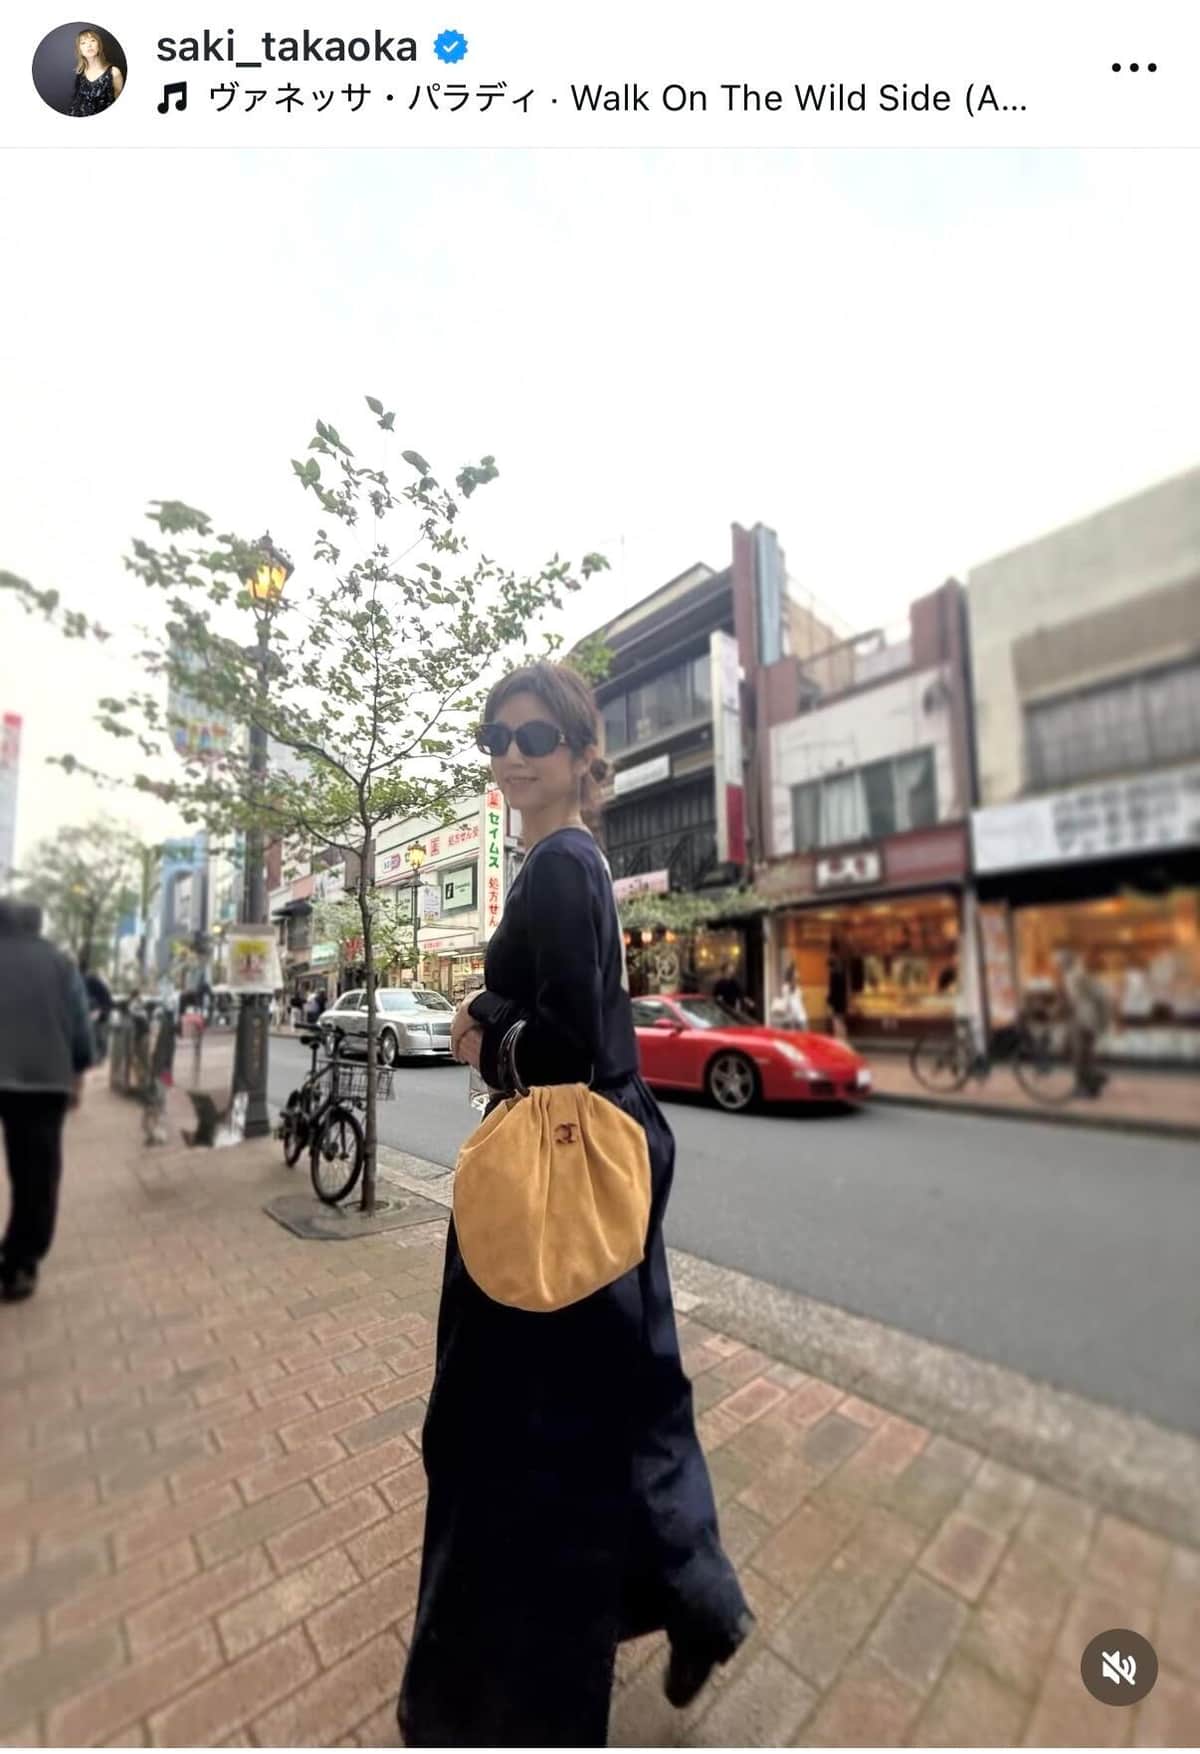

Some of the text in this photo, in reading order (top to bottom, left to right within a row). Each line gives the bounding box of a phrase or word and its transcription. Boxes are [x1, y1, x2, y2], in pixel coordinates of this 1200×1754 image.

[488, 811, 500, 868] セイムス
[488, 877, 500, 927] 処方せん
